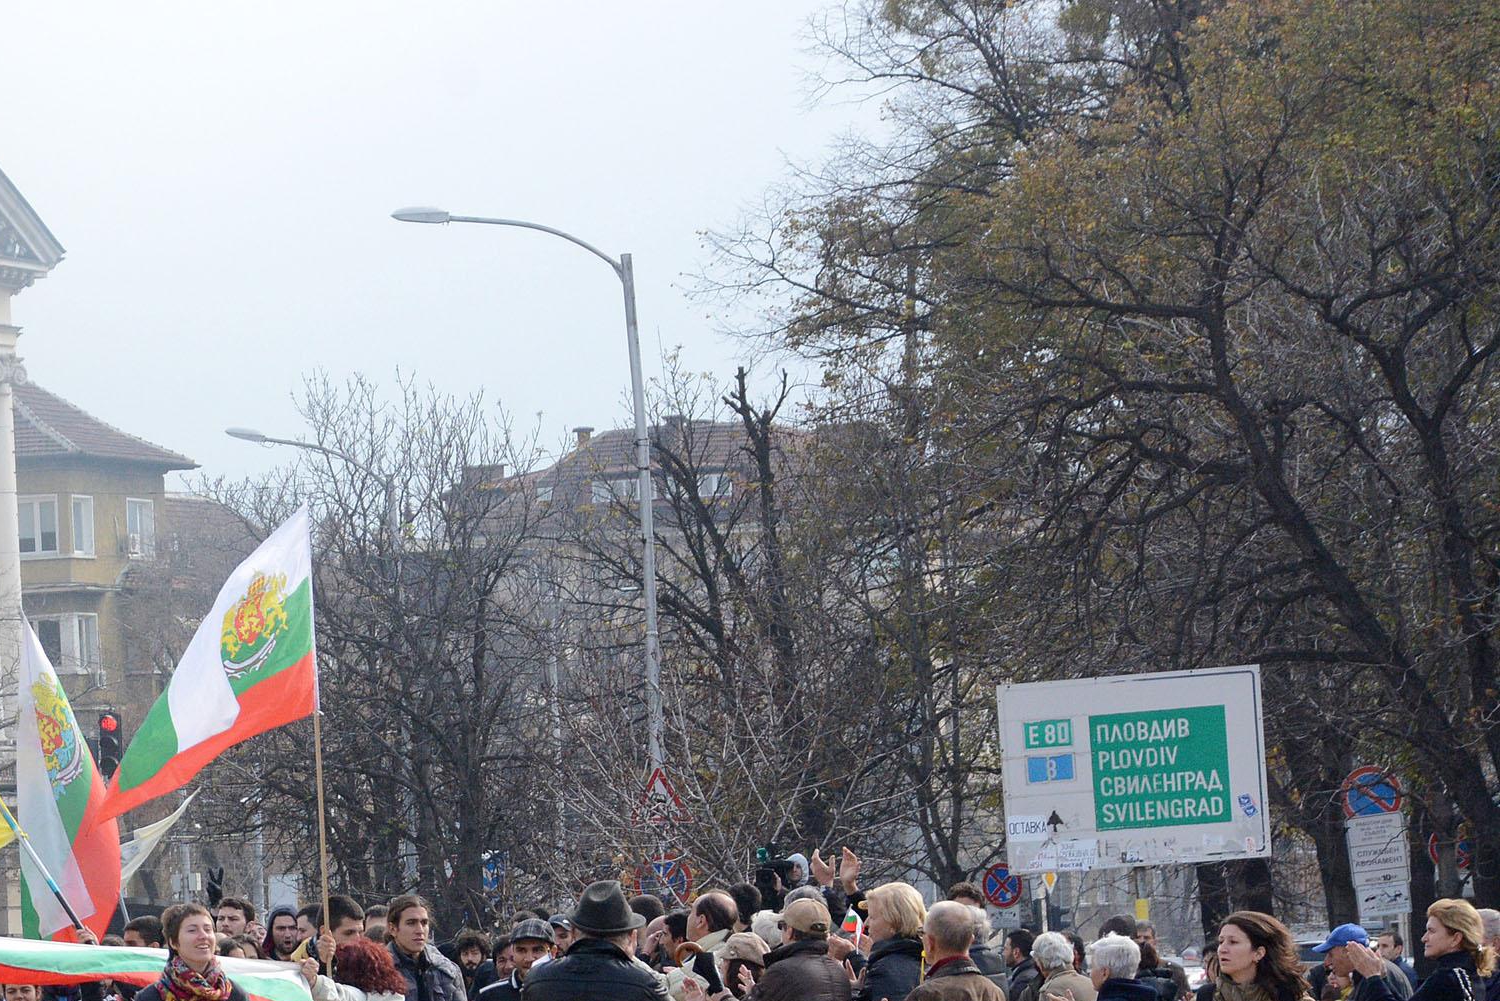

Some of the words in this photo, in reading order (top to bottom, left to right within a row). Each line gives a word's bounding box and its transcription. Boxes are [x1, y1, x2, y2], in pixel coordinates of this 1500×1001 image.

[1029, 725, 1040, 745] E
[1045, 722, 1070, 744] 80
[1096, 718, 1190, 744] ПЛОВДИВ
[1098, 746, 1178, 771] PLOVDIV
[1100, 769, 1223, 797] СВИЛЕНГРАД
[1102, 796, 1224, 823] SVILENGRAD
[1009, 821, 1047, 835] ОСТАВКА
[1355, 855, 1403, 867] АБОНАМЕНТ
